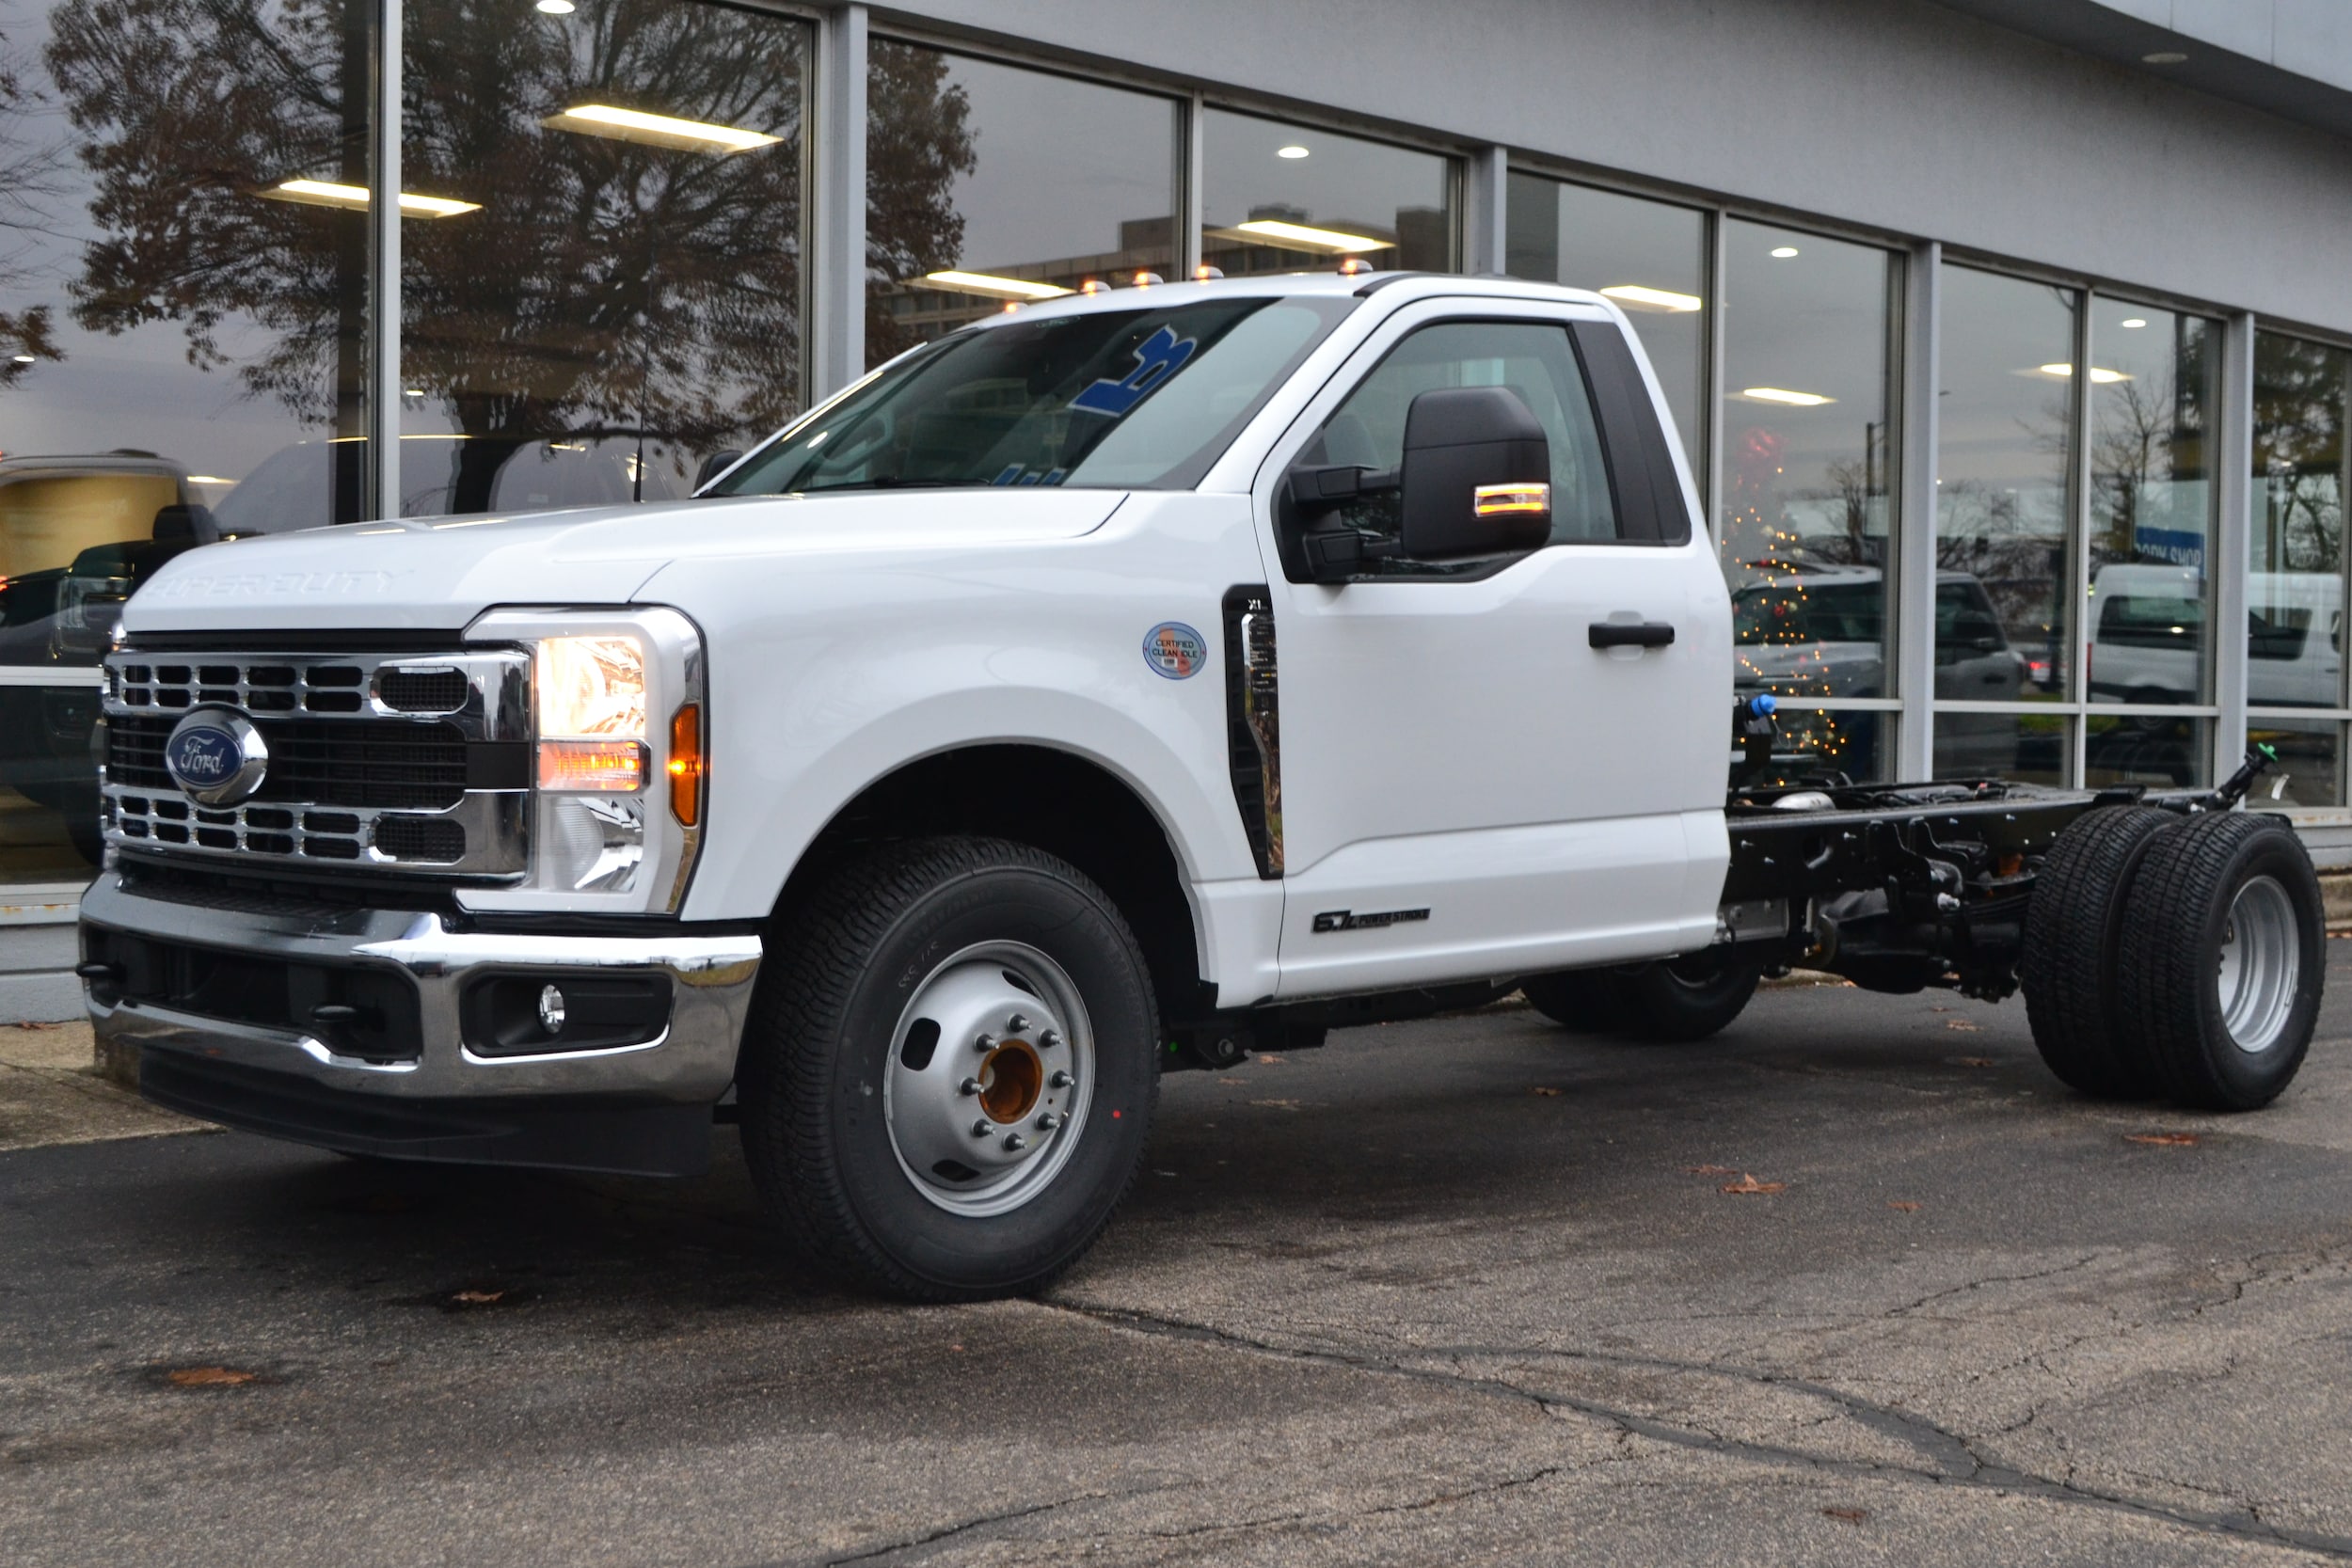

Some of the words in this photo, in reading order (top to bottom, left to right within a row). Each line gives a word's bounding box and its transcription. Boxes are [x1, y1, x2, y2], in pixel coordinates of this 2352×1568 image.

[2170, 546, 2201, 566] SHOP
[145, 573, 266, 597] SUPER
[265, 568, 406, 595] DUTY
[1152, 648, 1178, 657] CLEAN
[1181, 650, 1198, 658] IDLE
[1155, 640, 1194, 649] CERTIFIED
[181, 736, 225, 774] Ford
